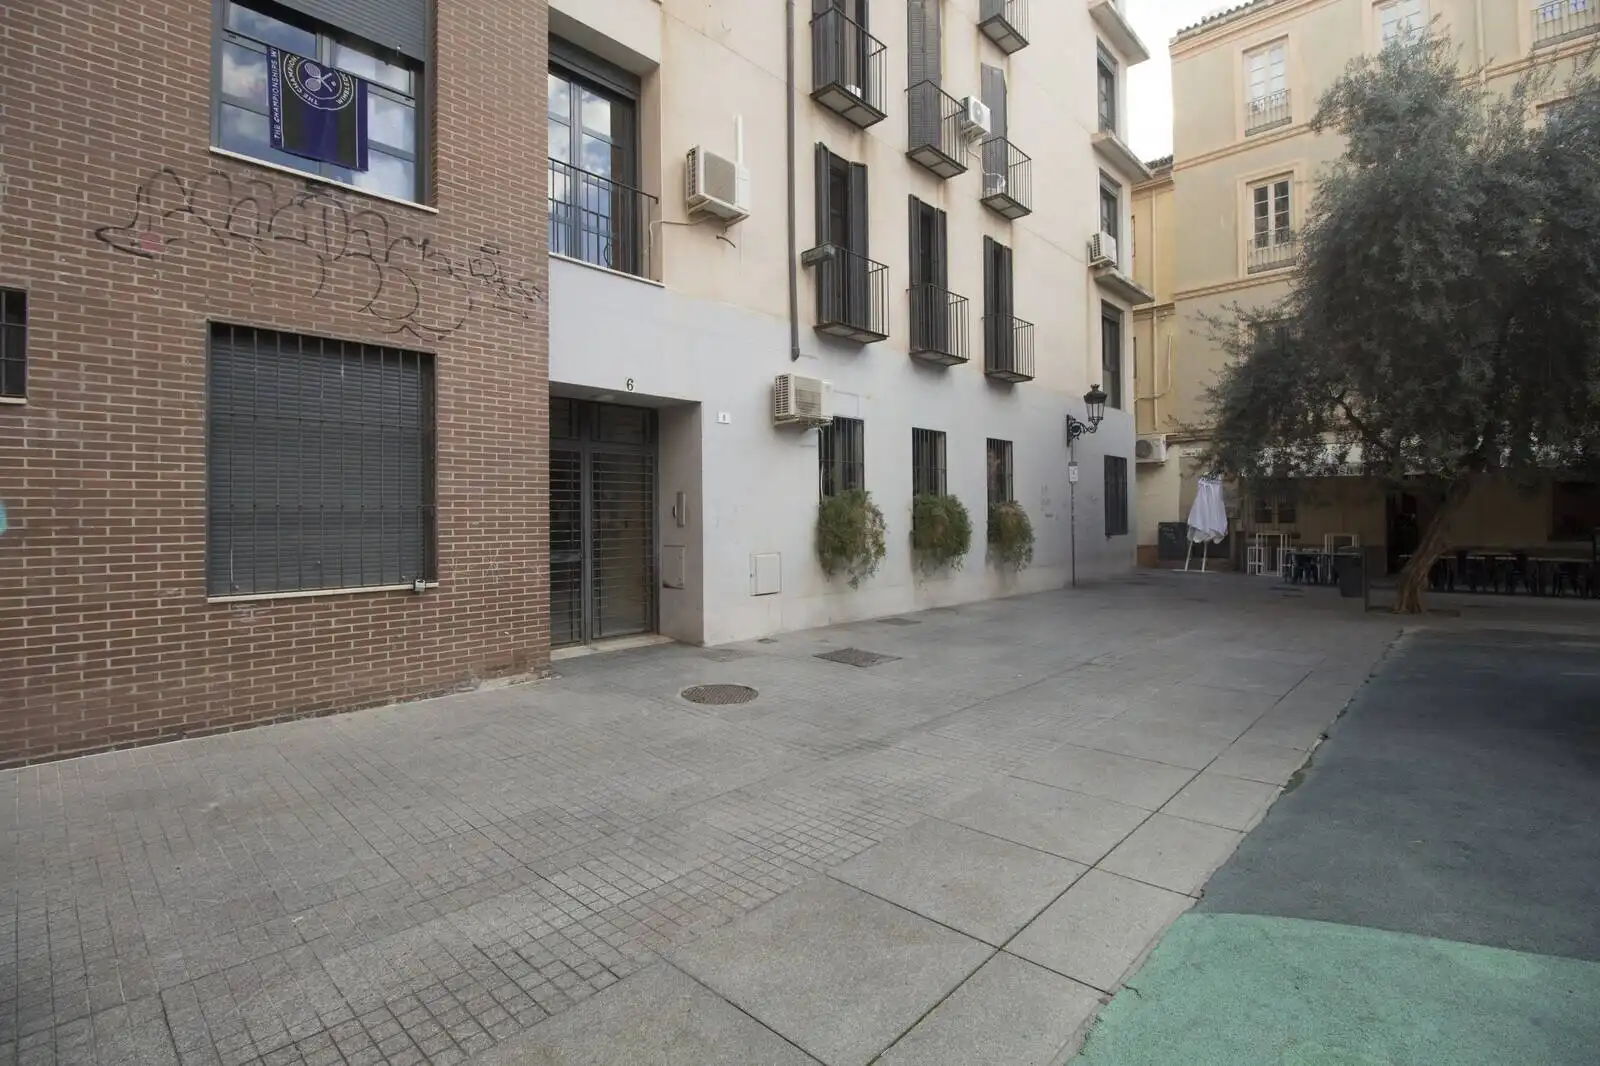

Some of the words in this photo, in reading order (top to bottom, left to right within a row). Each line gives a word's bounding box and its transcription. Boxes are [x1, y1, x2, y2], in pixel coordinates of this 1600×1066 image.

[271, 59, 280, 123] CHAMPIONSHIPS
[303, 93, 318, 105] THE
[273, 123, 281, 139] THE
[626, 378, 634, 391] 6
